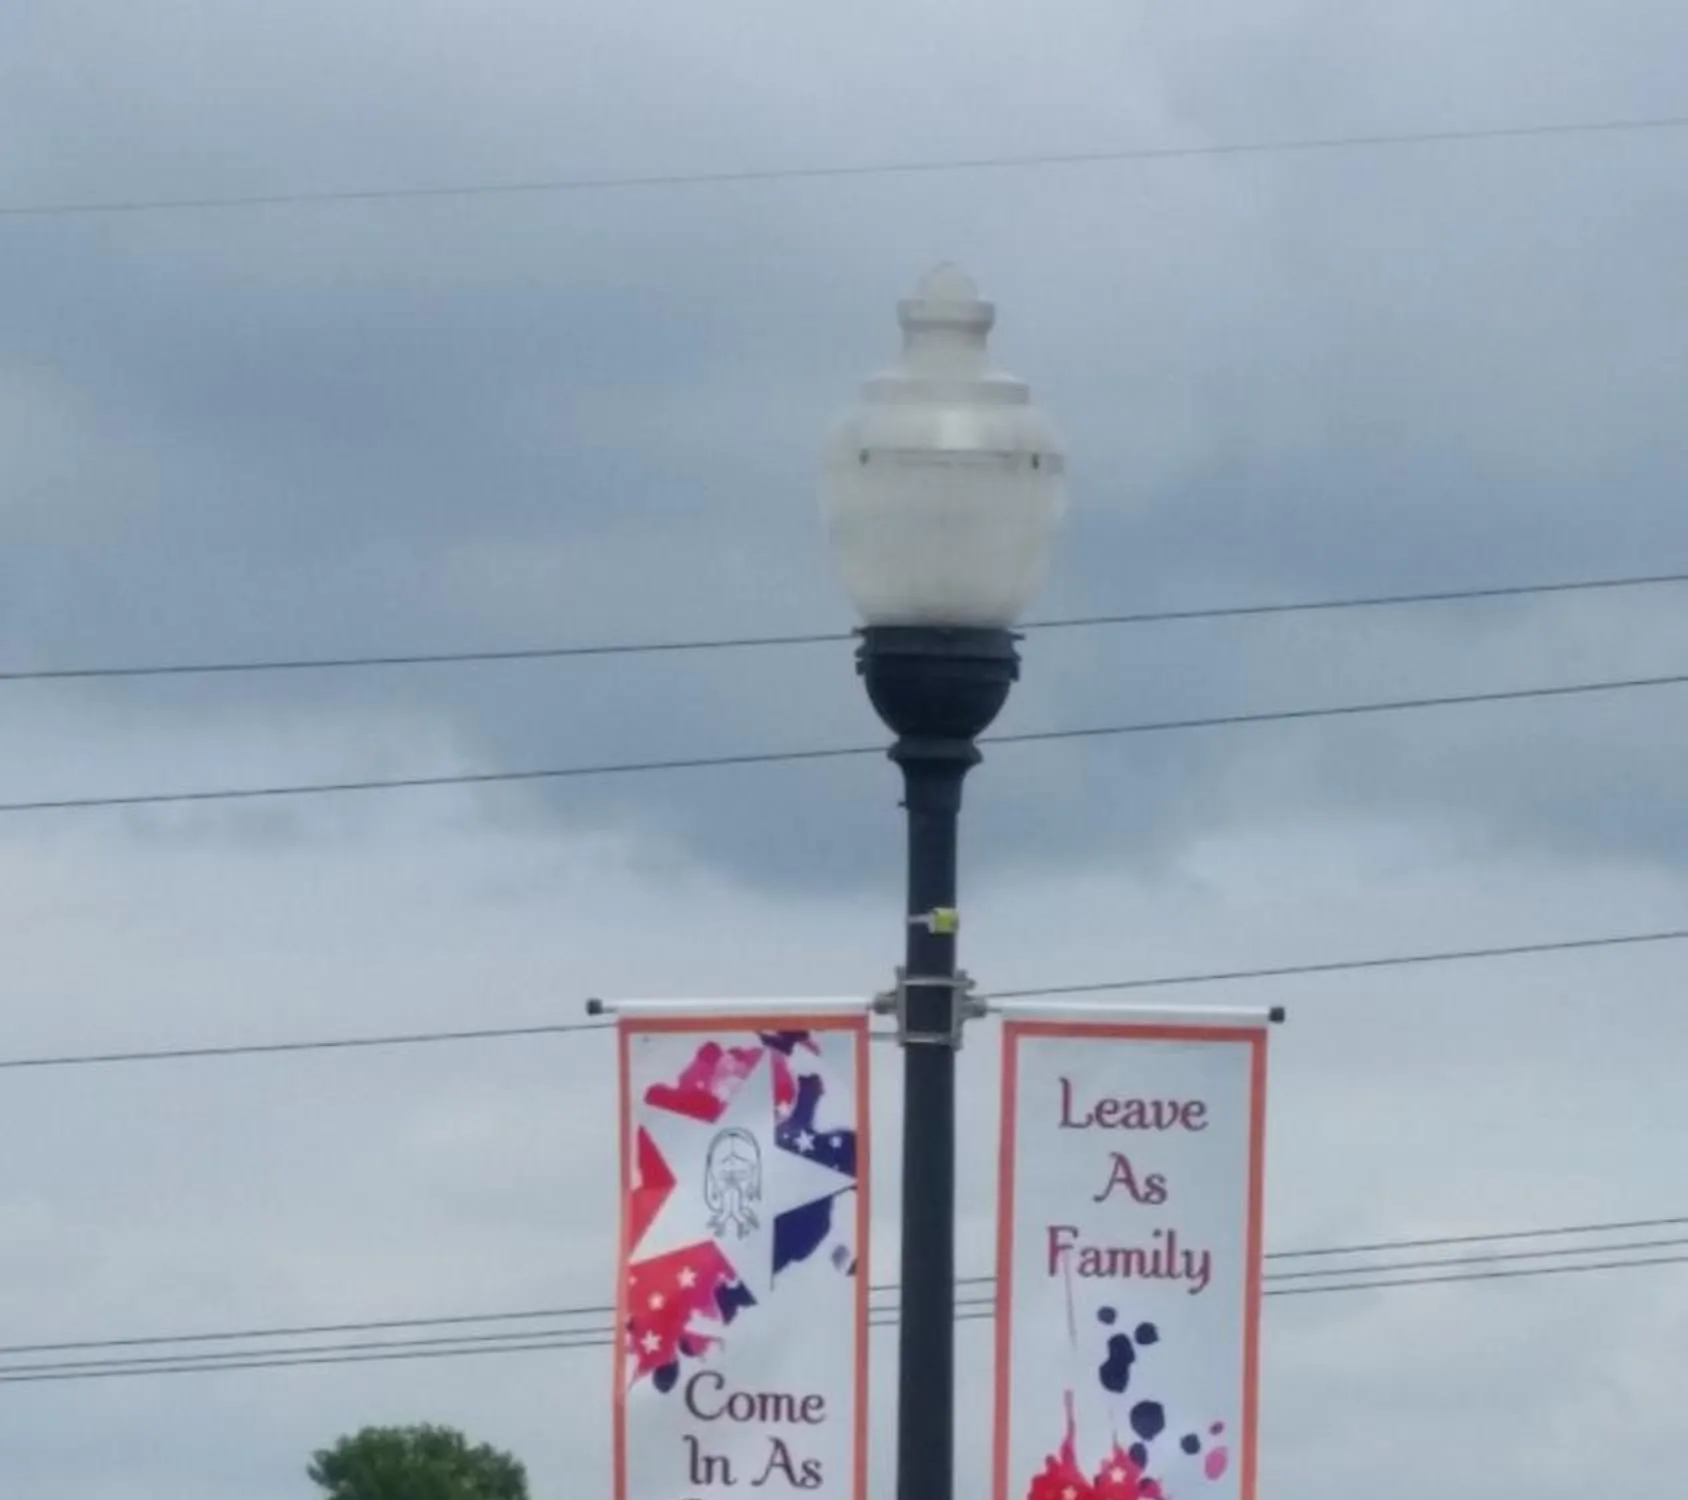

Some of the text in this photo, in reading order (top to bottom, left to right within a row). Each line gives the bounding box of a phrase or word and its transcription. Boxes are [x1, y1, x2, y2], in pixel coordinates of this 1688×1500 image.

[1058, 1076, 1209, 1132] Leave
[1093, 1151, 1168, 1205] As
[1046, 1224, 1211, 1295] Family
[684, 1369, 826, 1425] Come
[682, 1434, 824, 1490] In As
